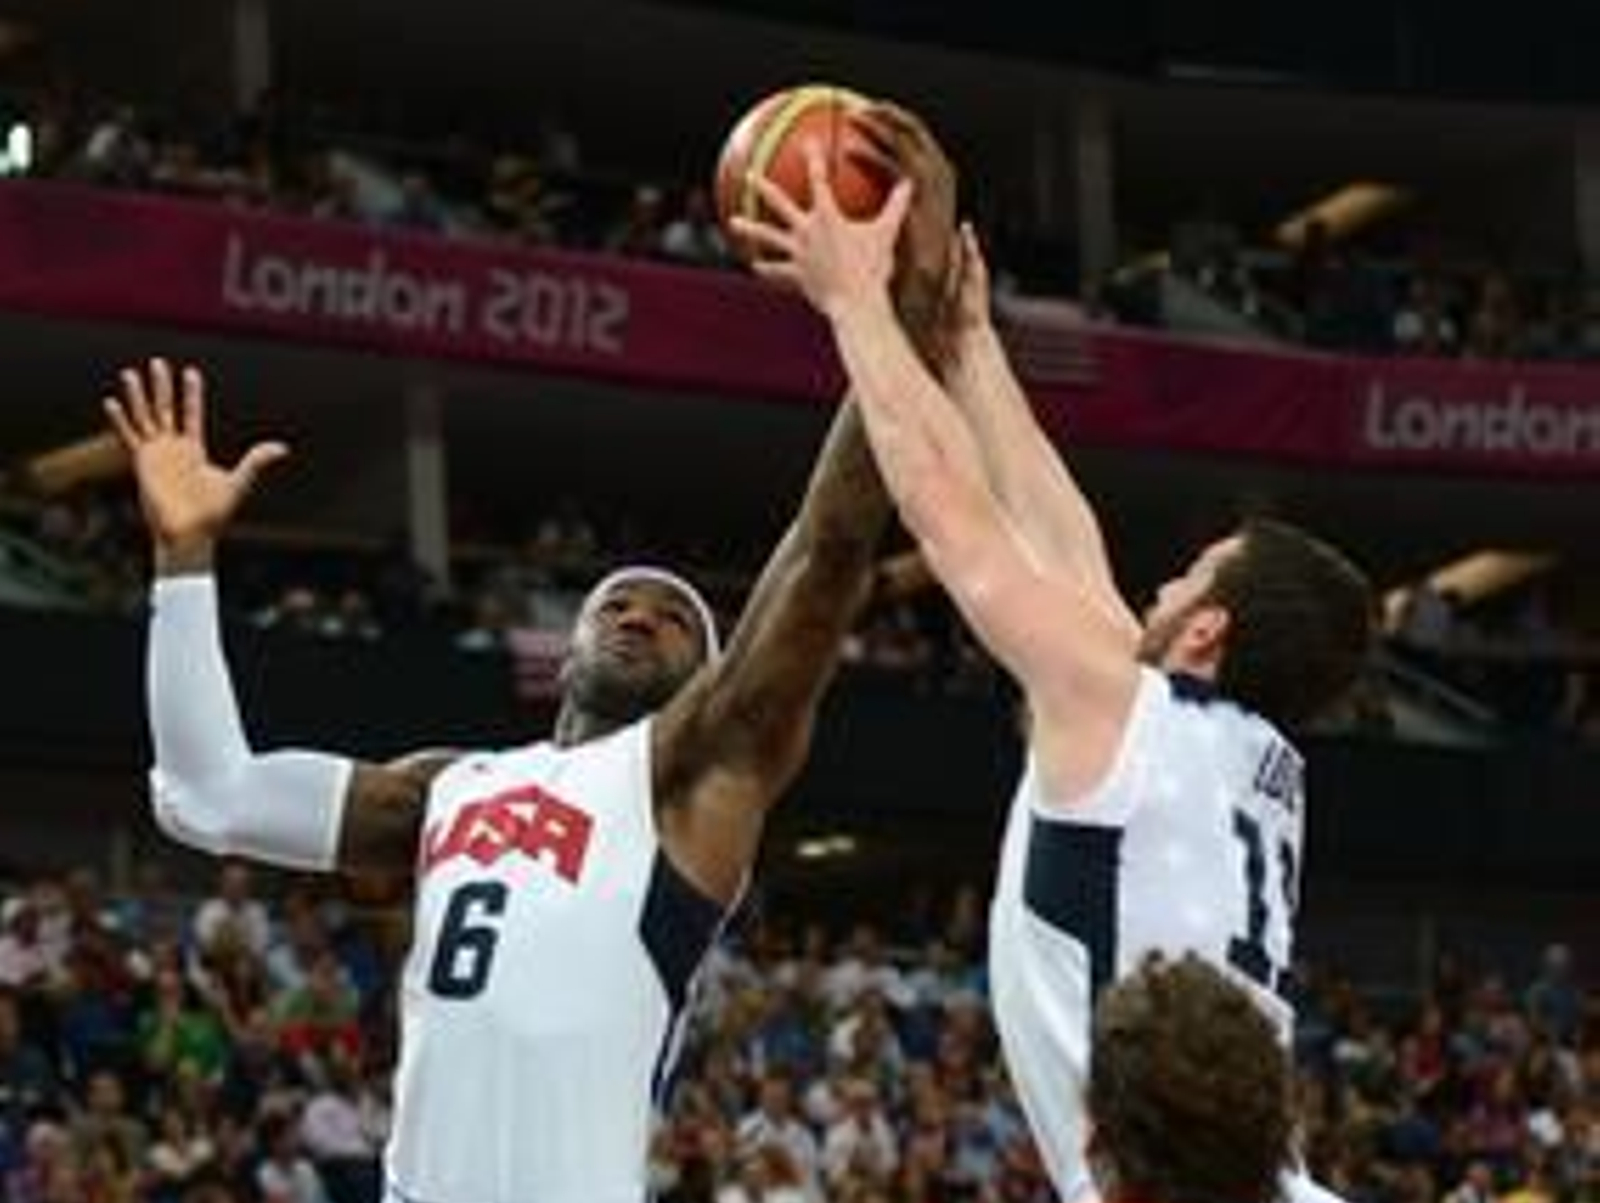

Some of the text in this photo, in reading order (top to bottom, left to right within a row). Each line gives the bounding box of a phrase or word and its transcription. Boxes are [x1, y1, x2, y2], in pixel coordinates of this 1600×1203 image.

[221, 231, 632, 356] London 2012
[1365, 378, 1600, 454] London
[421, 783, 593, 886] USA
[427, 881, 508, 1000] 6
